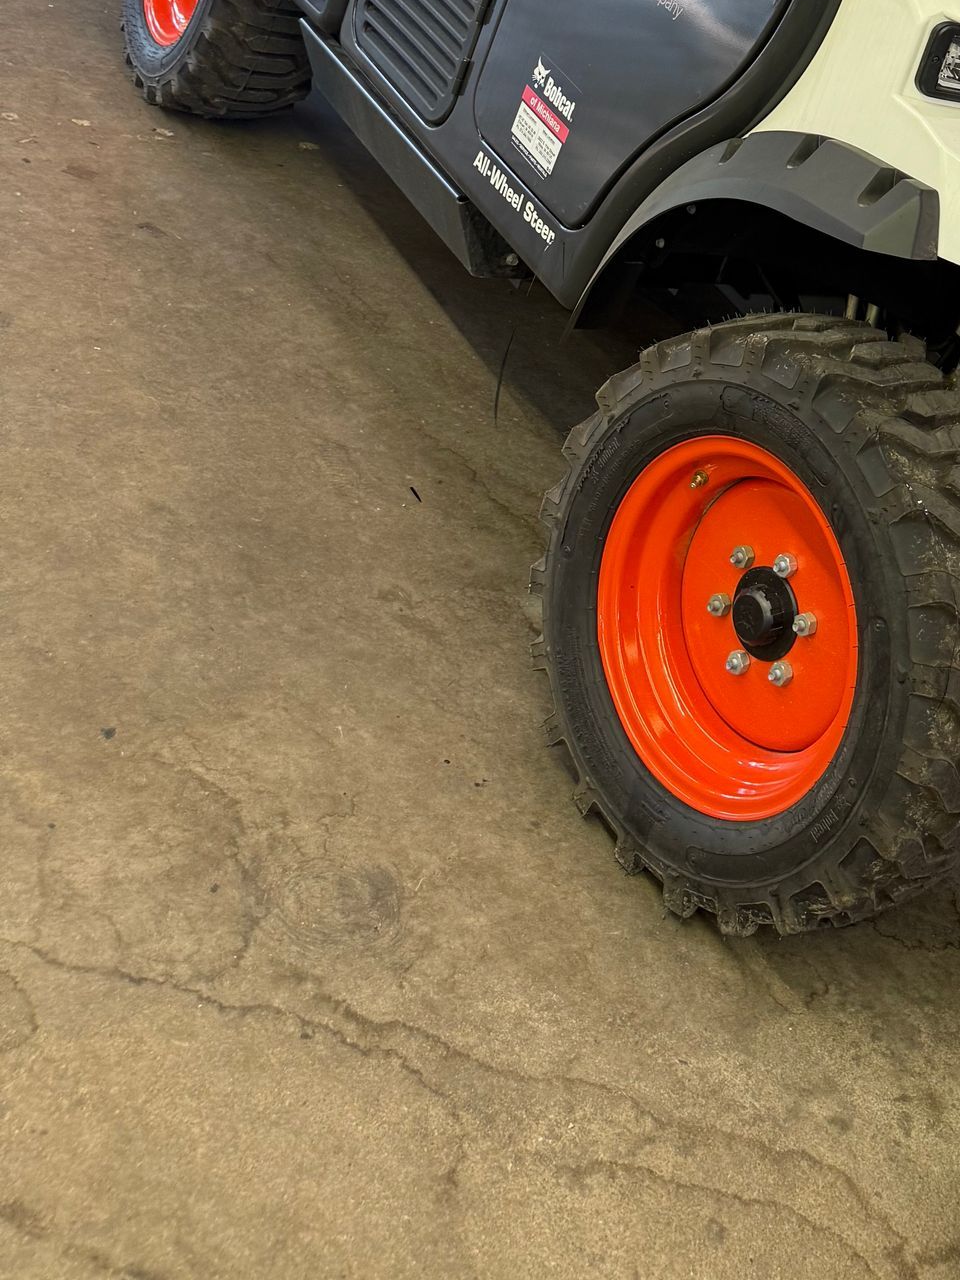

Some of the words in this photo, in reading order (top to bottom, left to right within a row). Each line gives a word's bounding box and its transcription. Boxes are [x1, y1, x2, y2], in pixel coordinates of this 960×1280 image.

[530, 96, 538, 108] of
[536, 101, 561, 133] Michiana
[543, 76, 576, 122] Bobcat
[473, 150, 524, 212] All-Wheel
[523, 201, 556, 244] Steer
